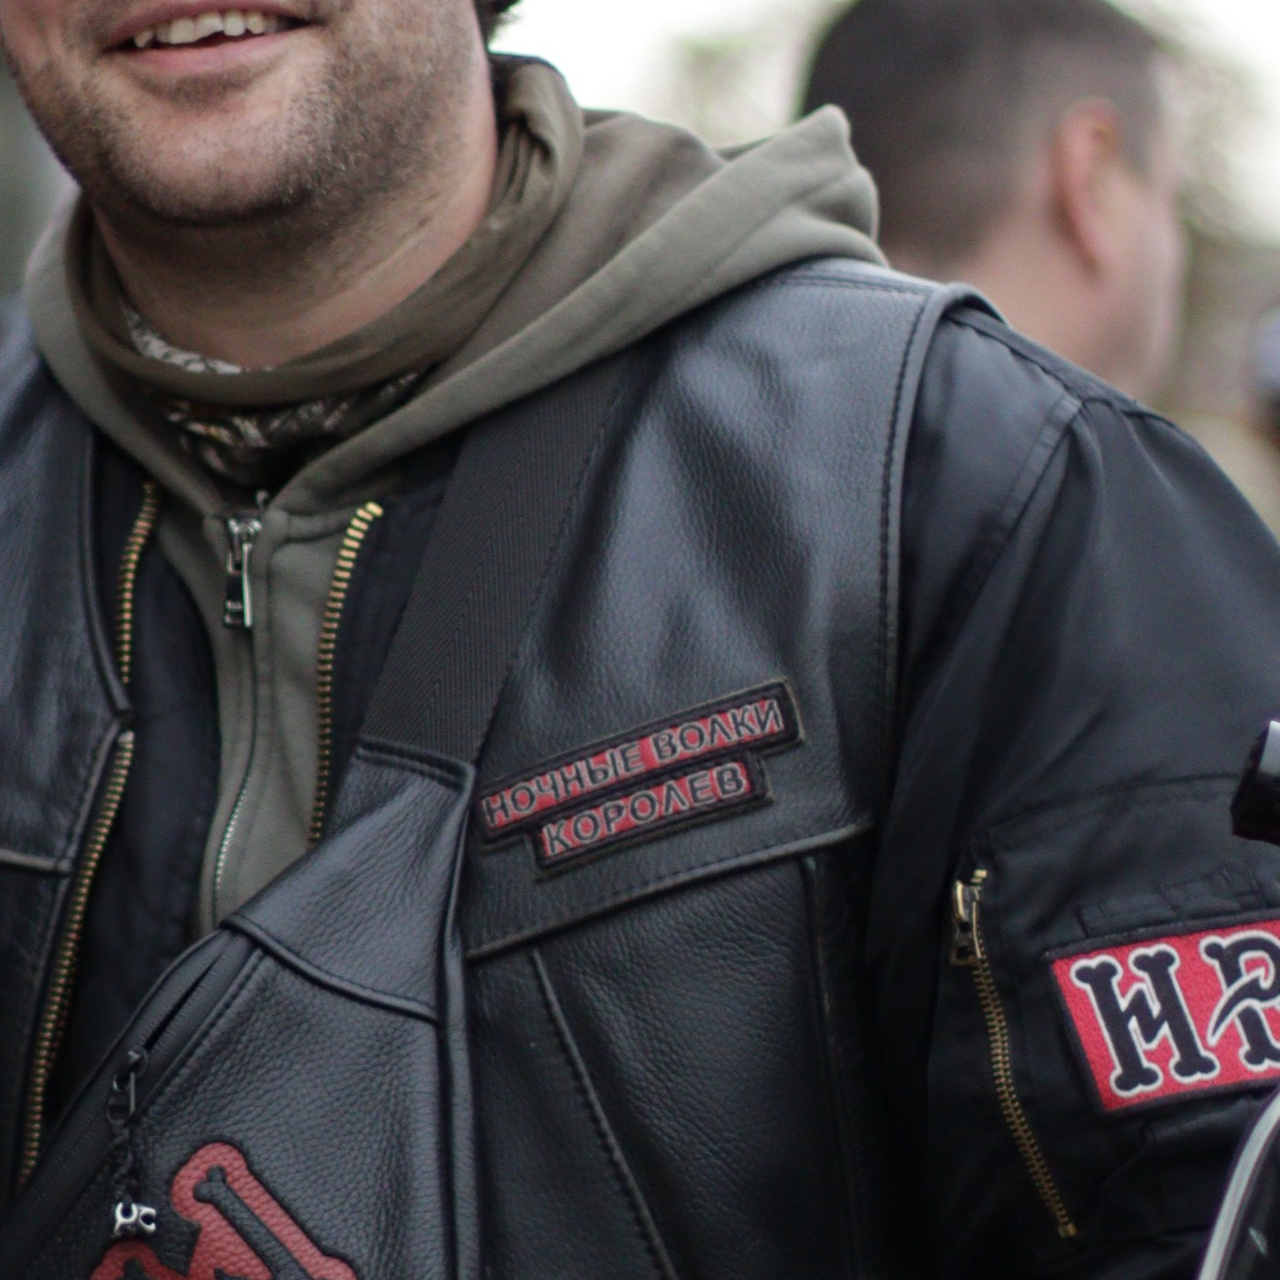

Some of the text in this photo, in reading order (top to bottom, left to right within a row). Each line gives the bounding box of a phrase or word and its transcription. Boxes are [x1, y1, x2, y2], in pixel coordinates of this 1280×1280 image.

[482, 699, 784, 825] НОЧНЫЕ ВОЛКИ
[541, 762, 749, 857] КОРОЛЕВ
